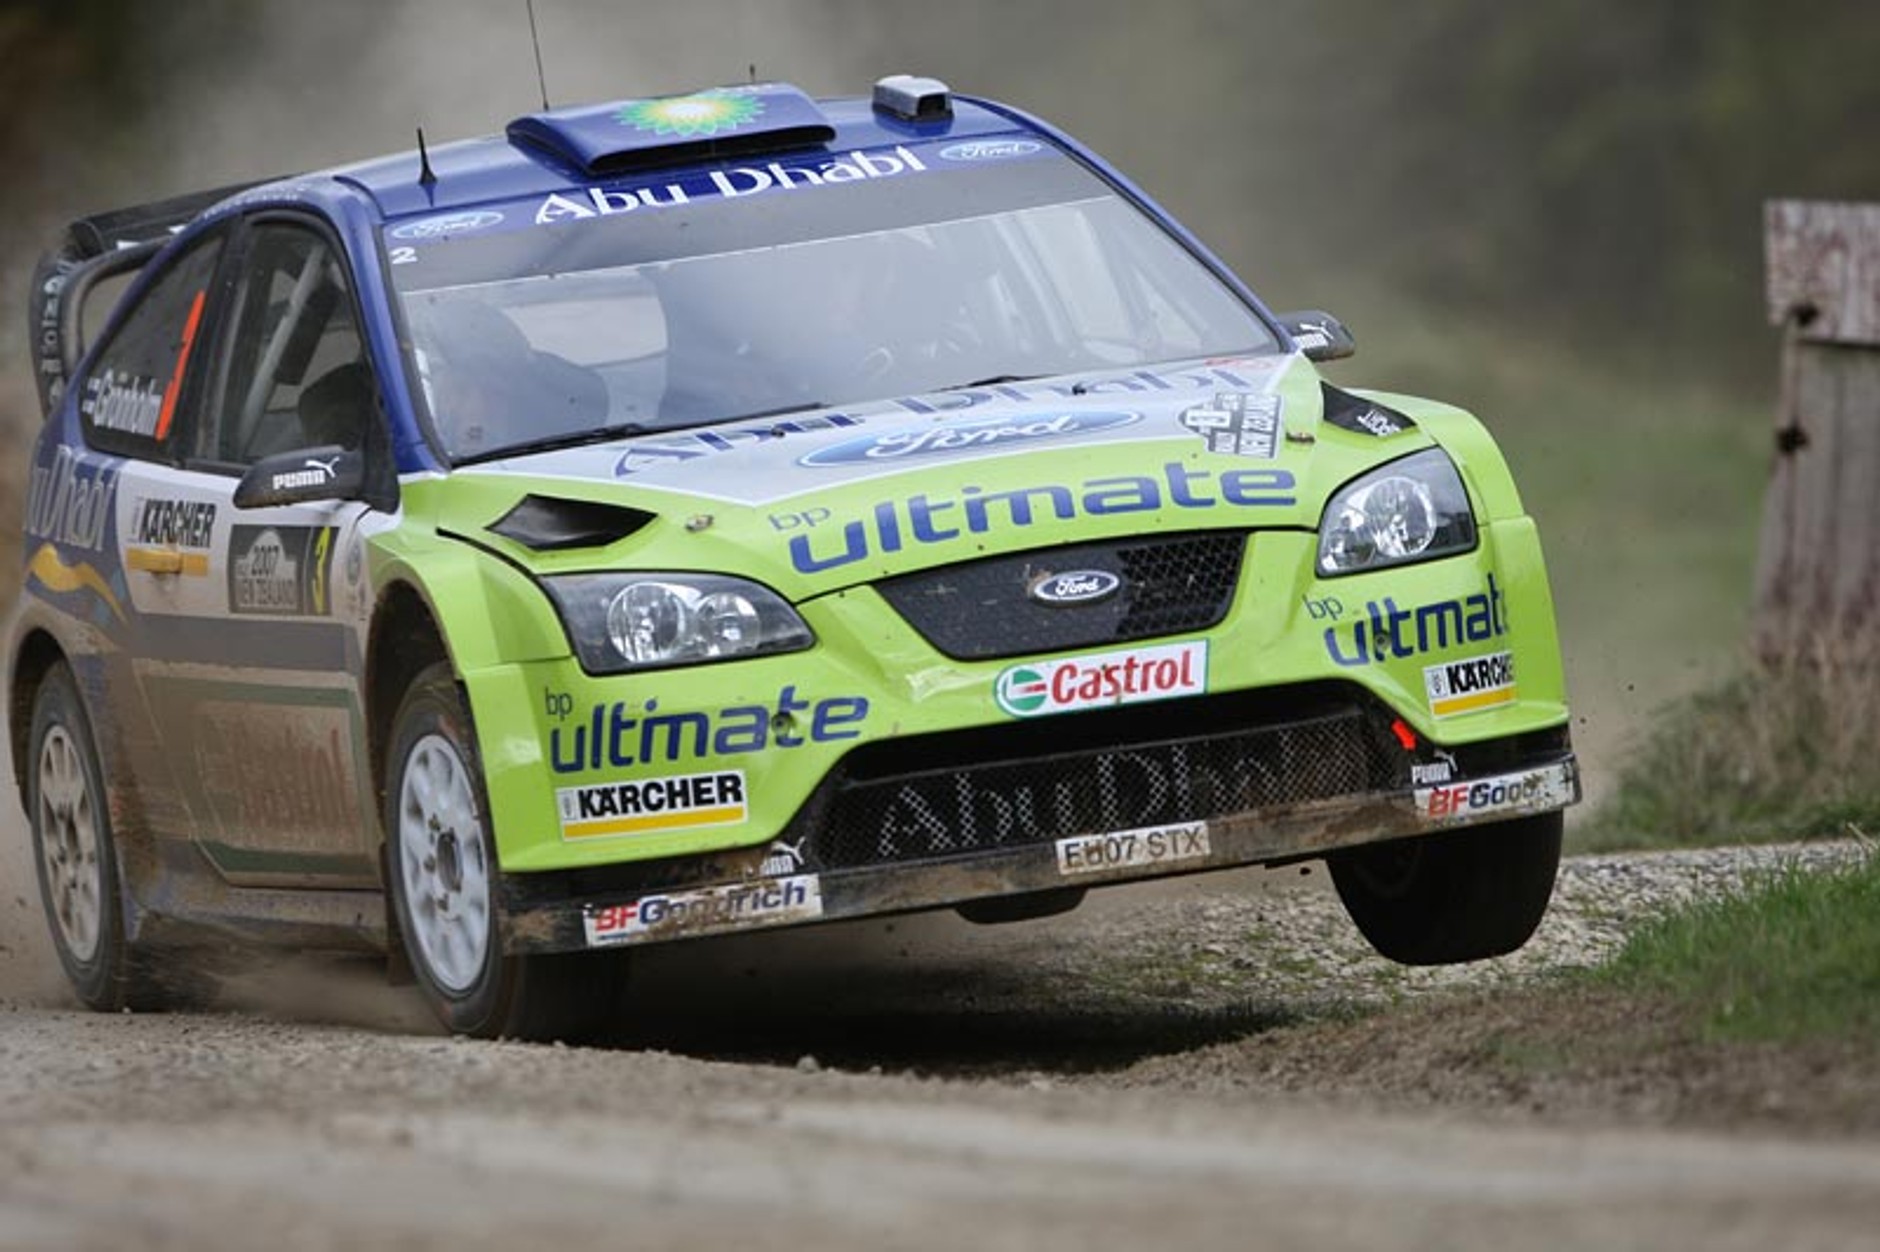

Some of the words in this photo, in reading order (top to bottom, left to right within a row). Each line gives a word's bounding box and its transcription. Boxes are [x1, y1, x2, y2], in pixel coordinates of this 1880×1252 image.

[535, 185, 690, 225] Abu
[709, 145, 928, 199] Dhabi
[390, 246, 418, 265] 2
[768, 506, 831, 532] bp
[788, 462, 1298, 576] ultimate
[312, 525, 332, 614] 3
[1302, 594, 1344, 621] bp
[1051, 648, 1196, 705] Castrol
[544, 686, 574, 722] bp
[551, 685, 870, 774] ultimate
[577, 773, 743, 819] KÄRCHER
[1146, 826, 1202, 859] STX
